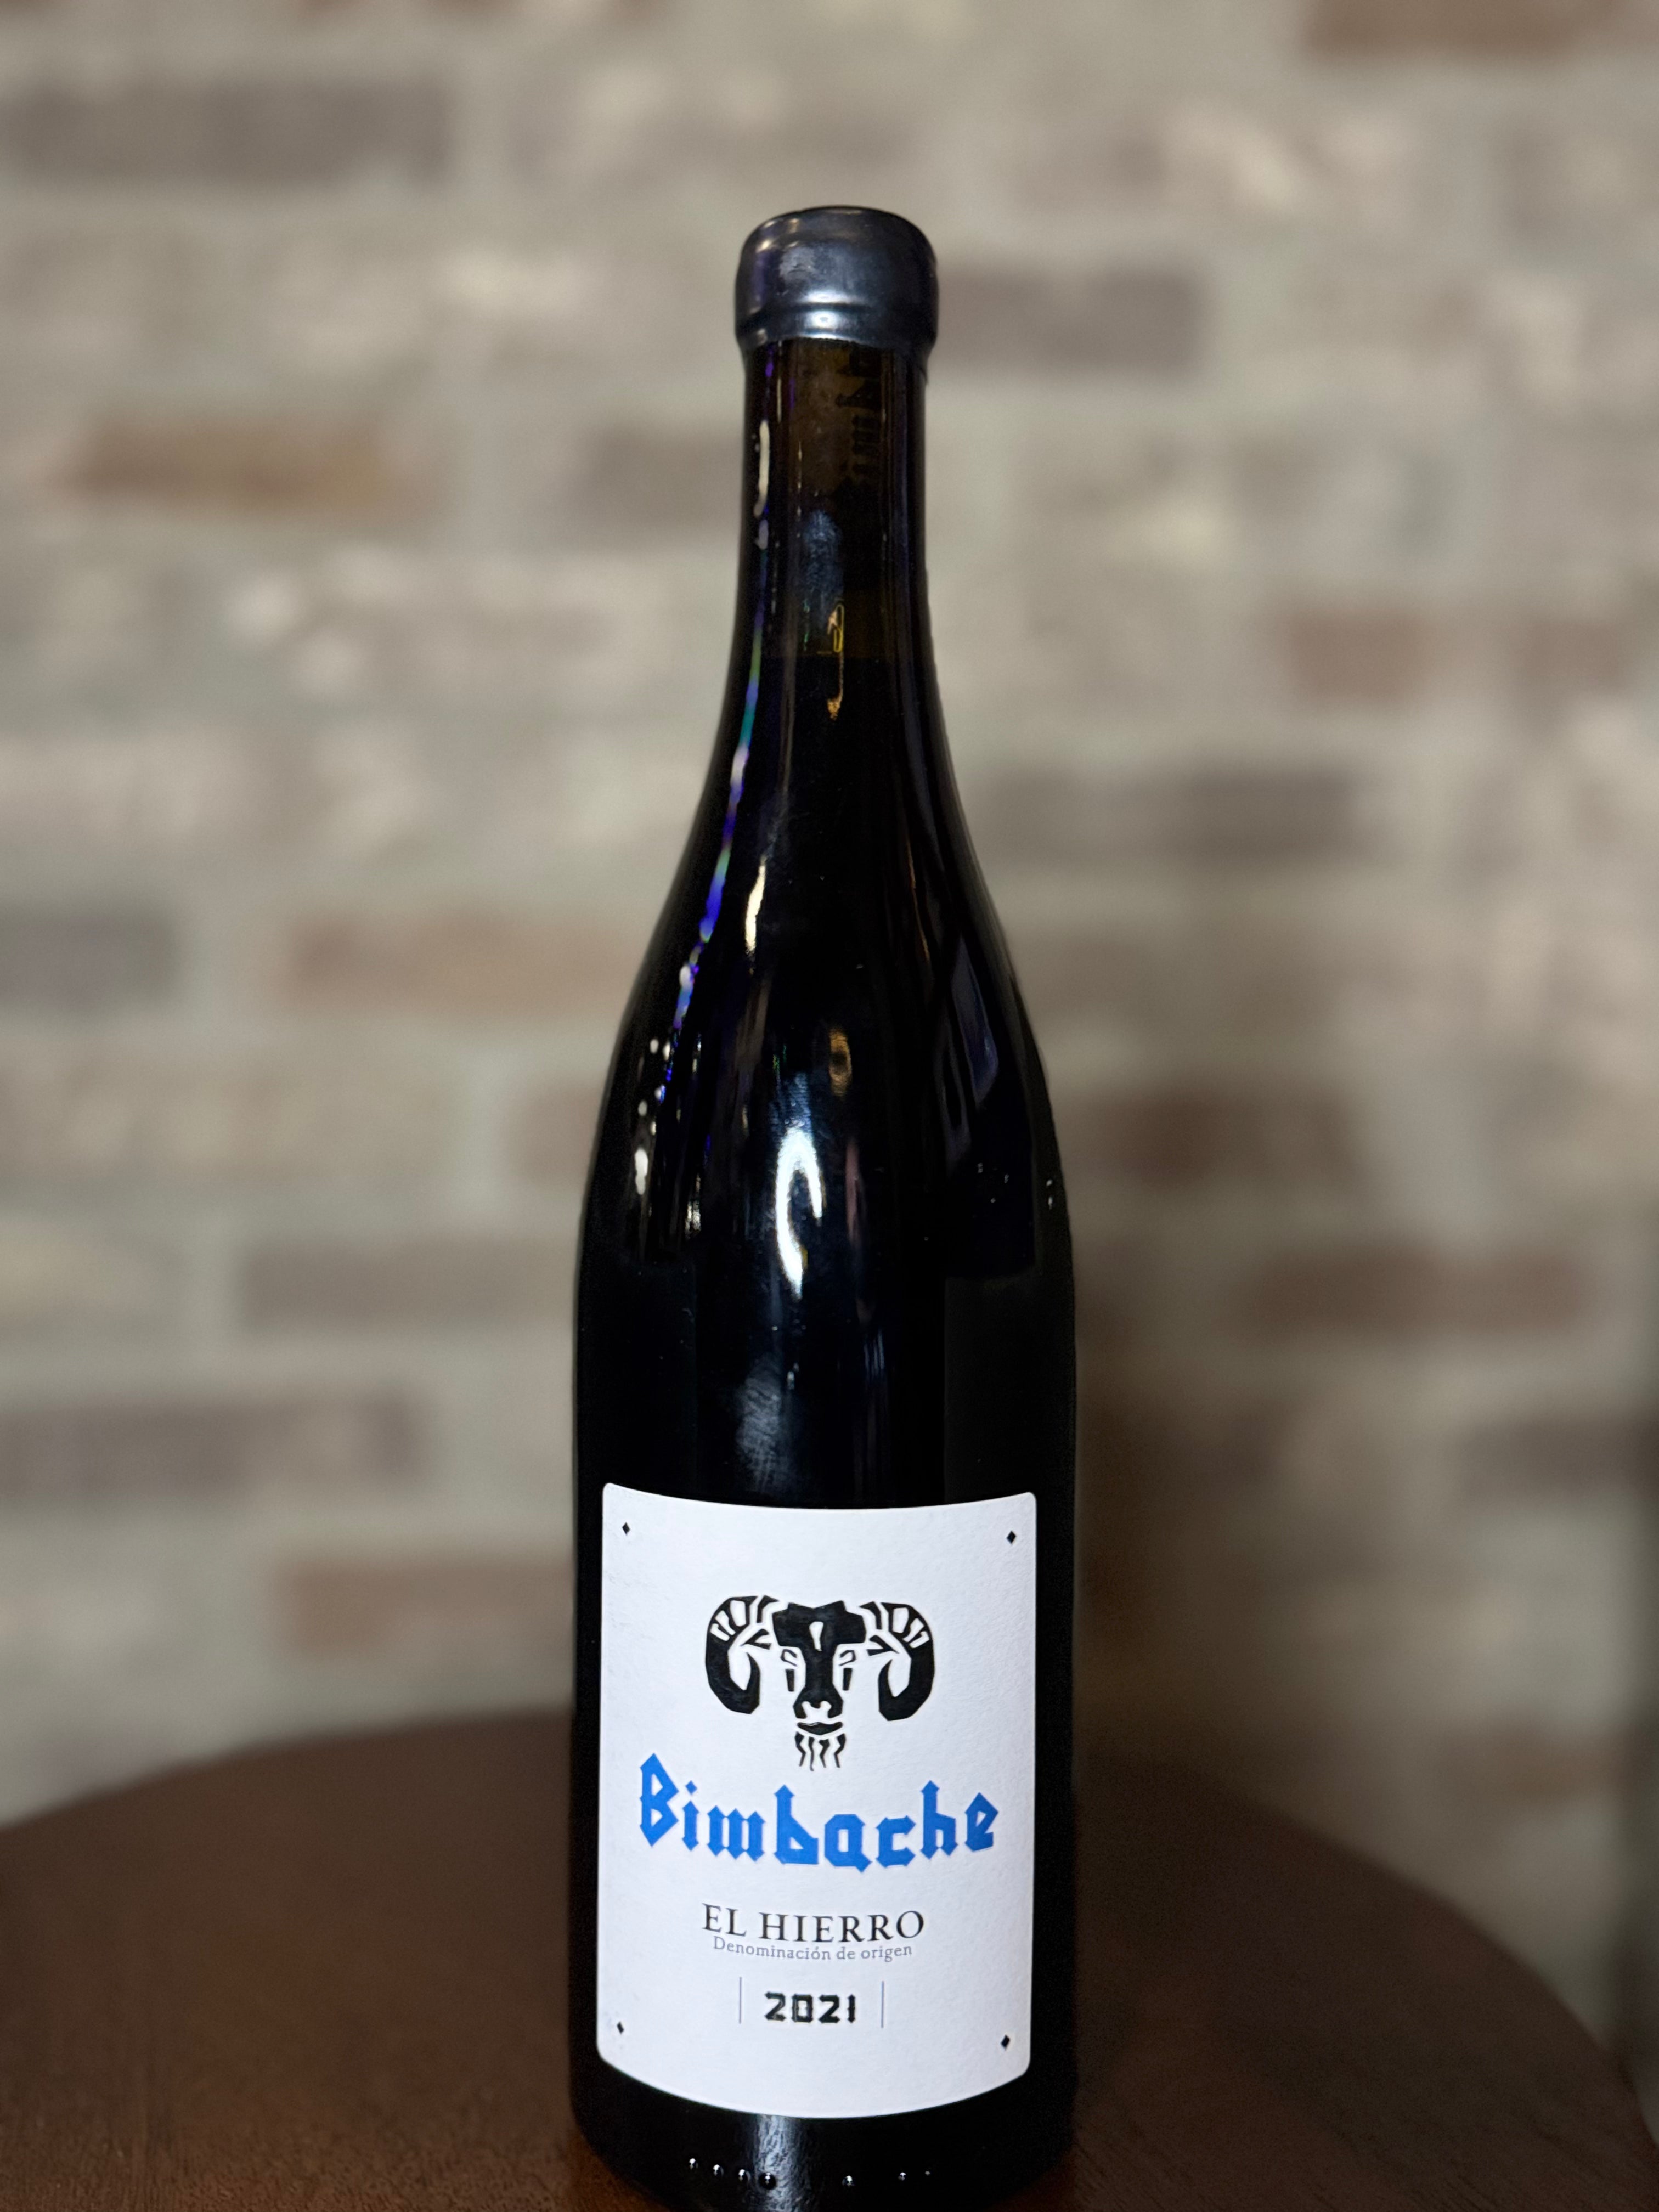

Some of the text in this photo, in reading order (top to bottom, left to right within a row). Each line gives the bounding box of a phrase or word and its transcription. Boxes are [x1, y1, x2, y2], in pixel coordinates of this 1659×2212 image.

[640, 1752, 999, 1872] Bimbache
[702, 1903, 925, 1943] EL HIERRO
[712, 1935, 912, 1963] Denominación de origen
[764, 1991, 856, 2024] 2021
